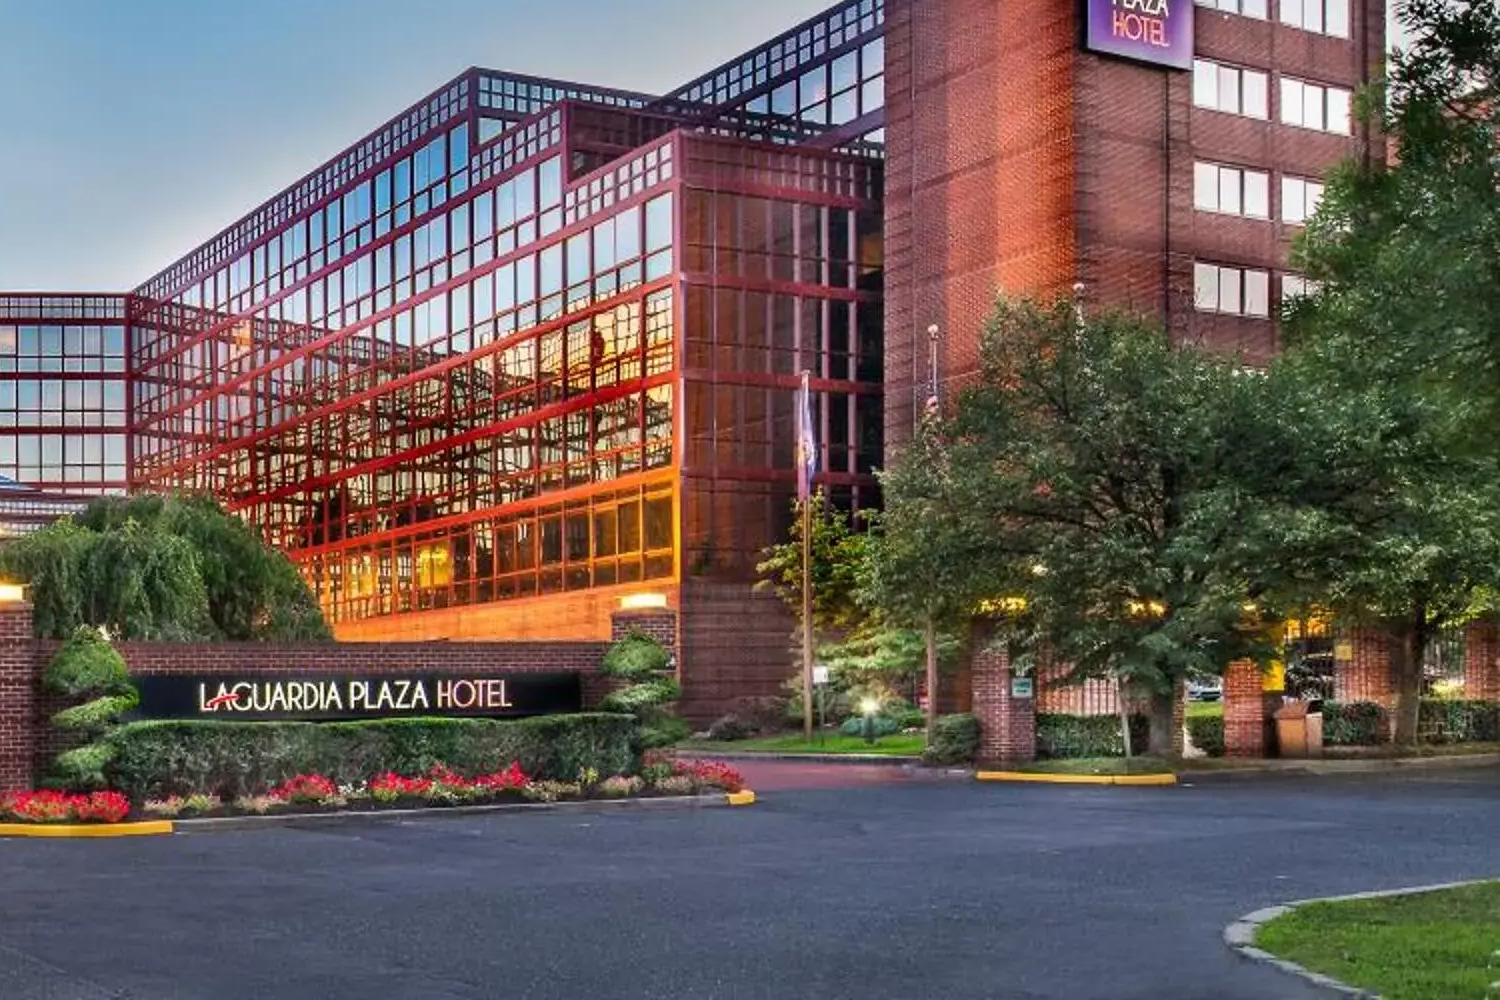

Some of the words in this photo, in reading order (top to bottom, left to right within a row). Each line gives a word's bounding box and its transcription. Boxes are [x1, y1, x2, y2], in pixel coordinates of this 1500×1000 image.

[1112, 9, 1170, 47] HOTEL
[200, 681, 343, 712] LAGUARDIA
[350, 680, 429, 709] PLAZA
[437, 679, 513, 708] HOTEL
